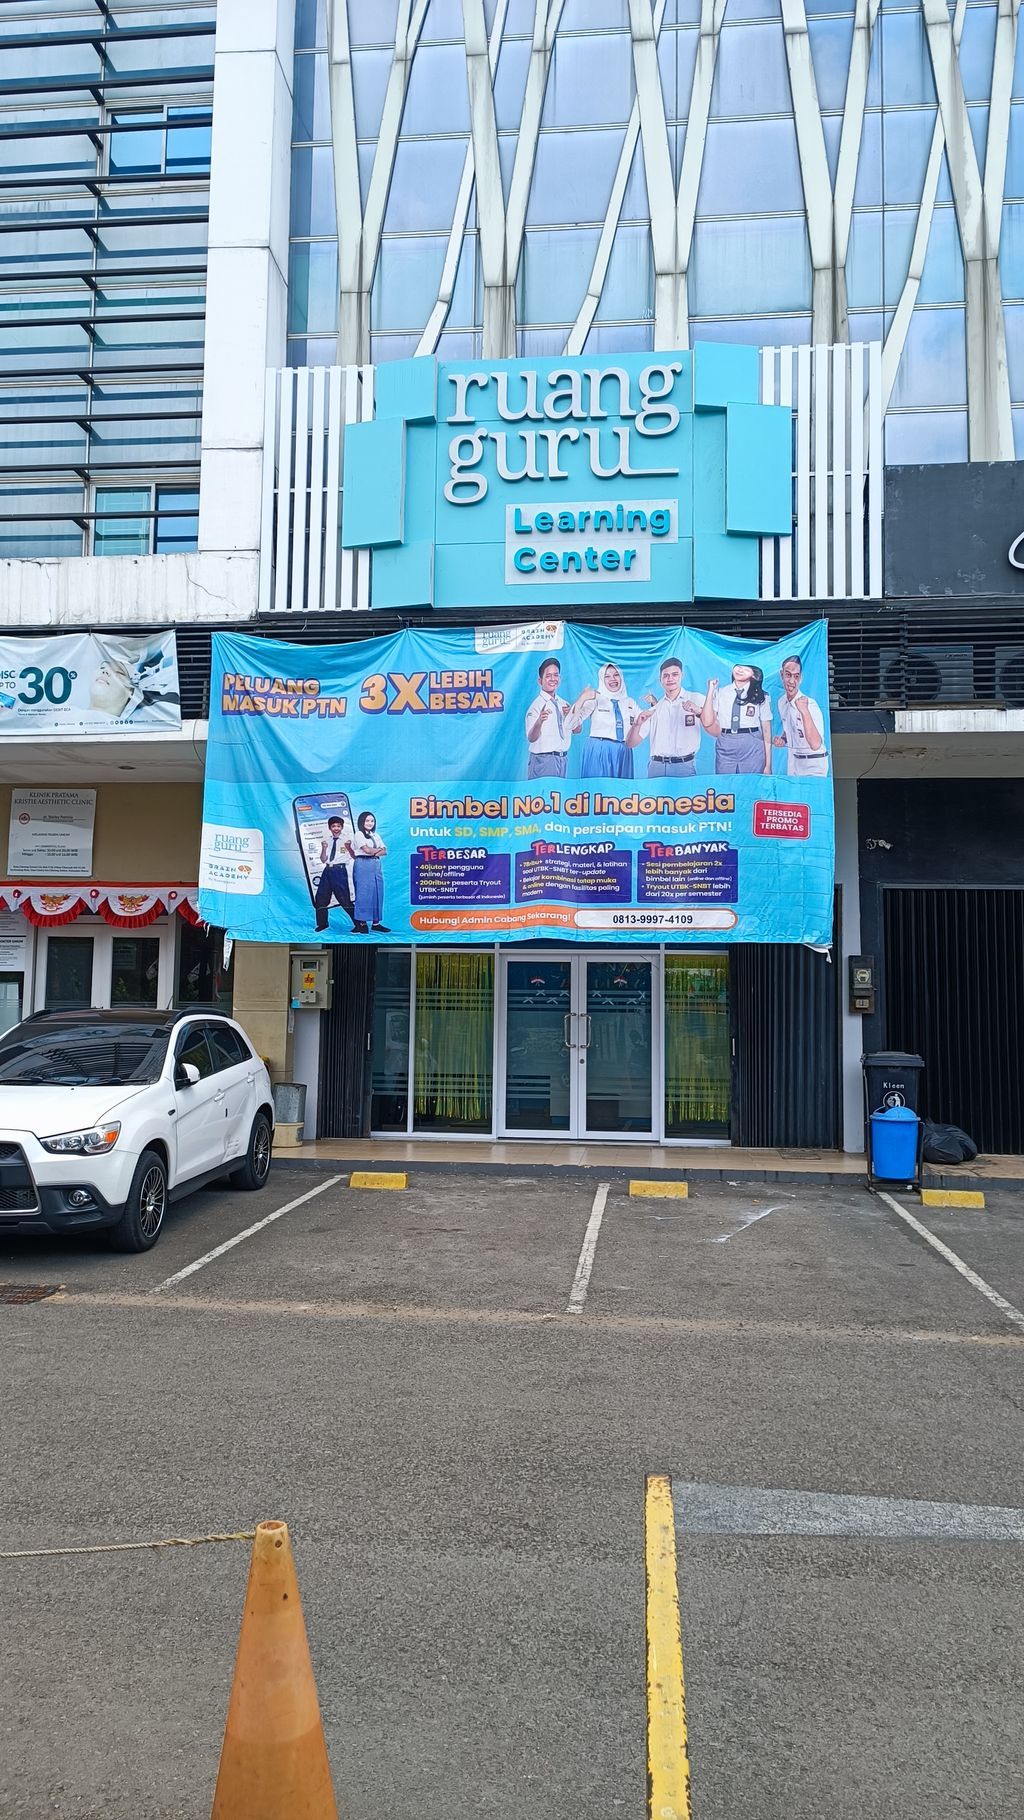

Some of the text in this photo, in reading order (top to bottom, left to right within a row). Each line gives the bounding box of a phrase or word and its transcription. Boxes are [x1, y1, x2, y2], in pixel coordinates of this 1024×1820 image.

[445, 362, 683, 436] ruang
[443, 426, 679, 505] guru
[513, 503, 671, 535] Learning
[513, 546, 637, 574] Center
[0, 670, 16, 679] ISC
[429, 669, 493, 690] LEBIH
[5, 681, 16, 689] TO
[222, 672, 321, 696] PELUANG
[359, 672, 429, 713] 3X
[222, 694, 347, 717] MASUK PTN
[429, 691, 503, 711] BESAR
[410, 789, 735, 819] Bimbel No.1 di Indonesia
[762, 809, 802, 818] TERSEDIA
[766, 816, 799, 824] PROMO
[410, 827, 451, 837] Untuk
[454, 827, 476, 838] SD,
[479, 827, 512, 838] SMP,
[544, 822, 570, 833] dan
[573, 823, 643, 837] persiapan
[646, 822, 696, 834] masuk
[699, 822, 732, 832] PTN!
[760, 823, 804, 831] TERBATAS
[213, 841, 248, 853] guru
[215, 834, 250, 848] ruang
[208, 864, 236, 872] BRAIN
[208, 870, 249, 880] ACADEMY
[541, 874, 577, 883] kombinasi
[545, 882, 571, 890] dengan
[419, 911, 571, 925] Hubungi Admin Cabang Sekarang!
[612, 914, 693, 925] 0813-9997-4109
